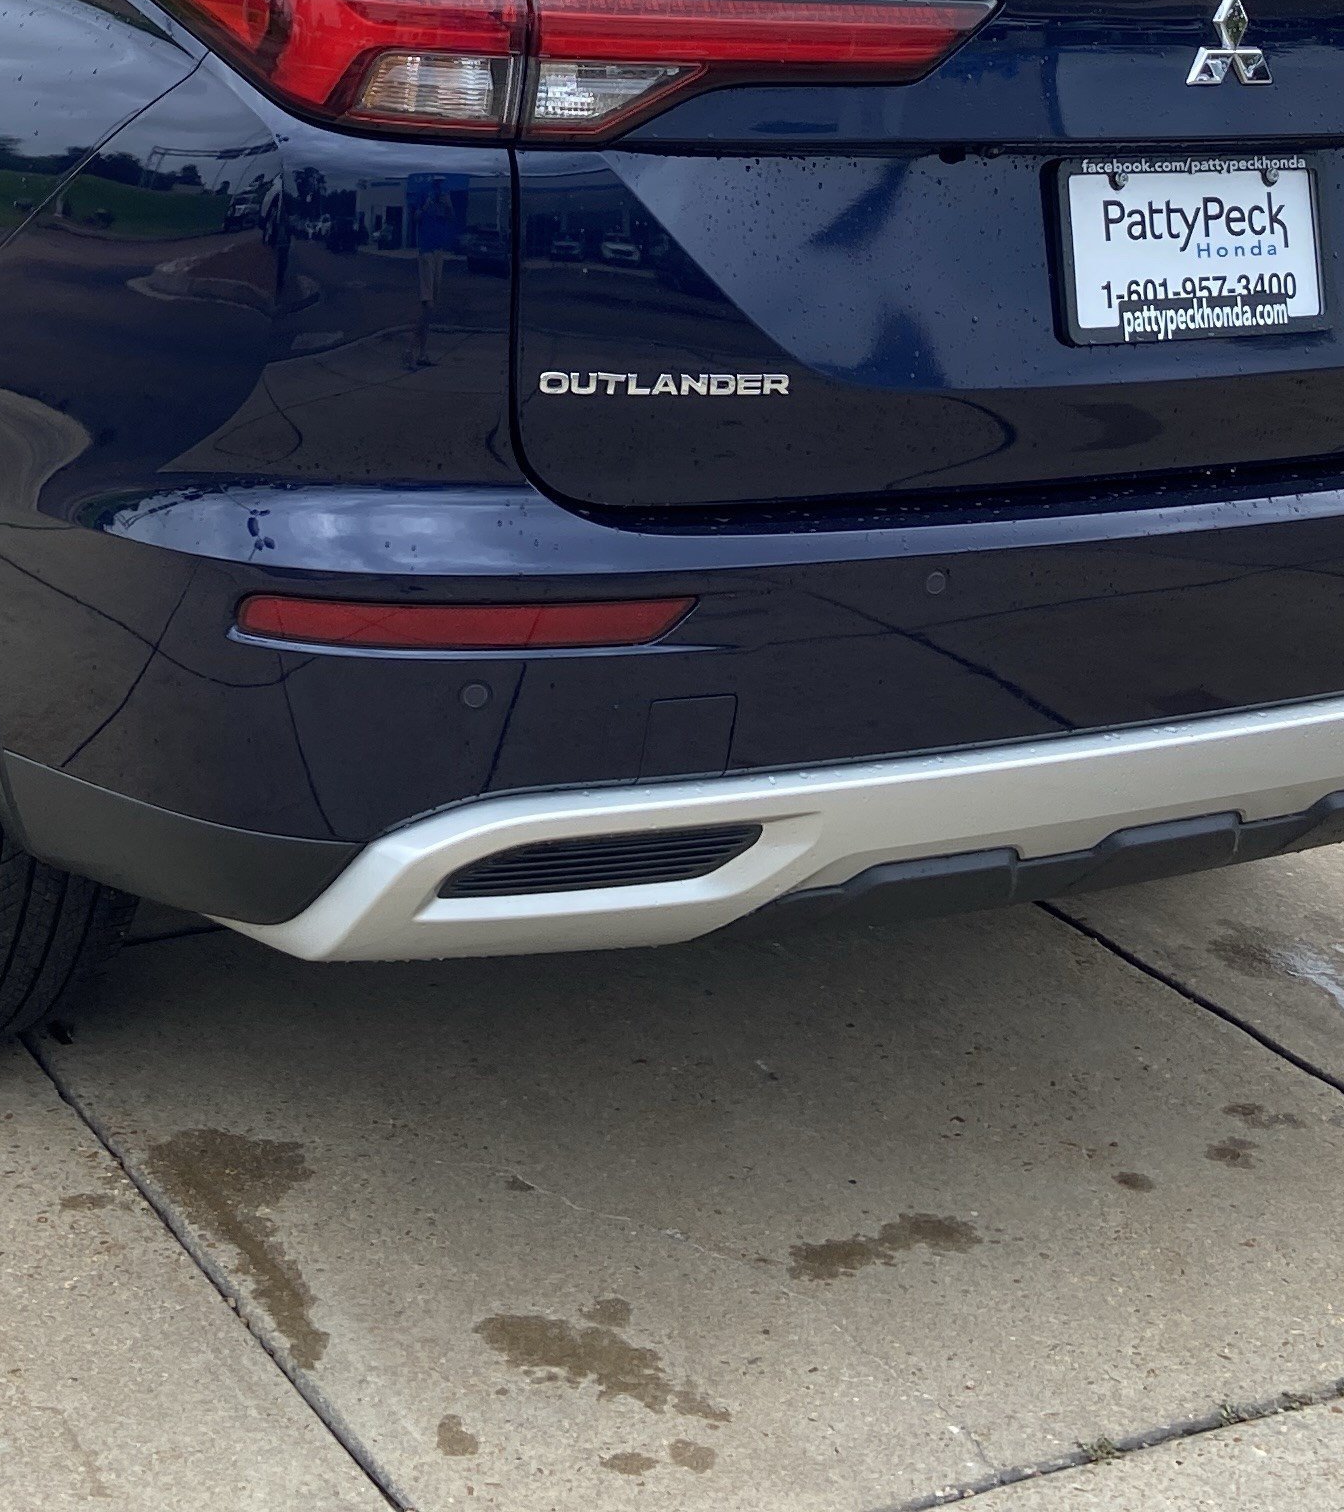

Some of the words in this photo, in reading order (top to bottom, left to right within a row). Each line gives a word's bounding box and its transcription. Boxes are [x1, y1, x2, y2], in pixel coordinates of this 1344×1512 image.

[1081, 155, 1306, 174] facebook.com/pattypeckhonda
[1102, 191, 1290, 252] PattyPeck
[1196, 240, 1278, 259] Honda
[1101, 271, 1297, 309] 1-601-957-3400
[1122, 296, 1289, 342] pattypeckhonda.com
[539, 371, 790, 396] OUTLANDER
